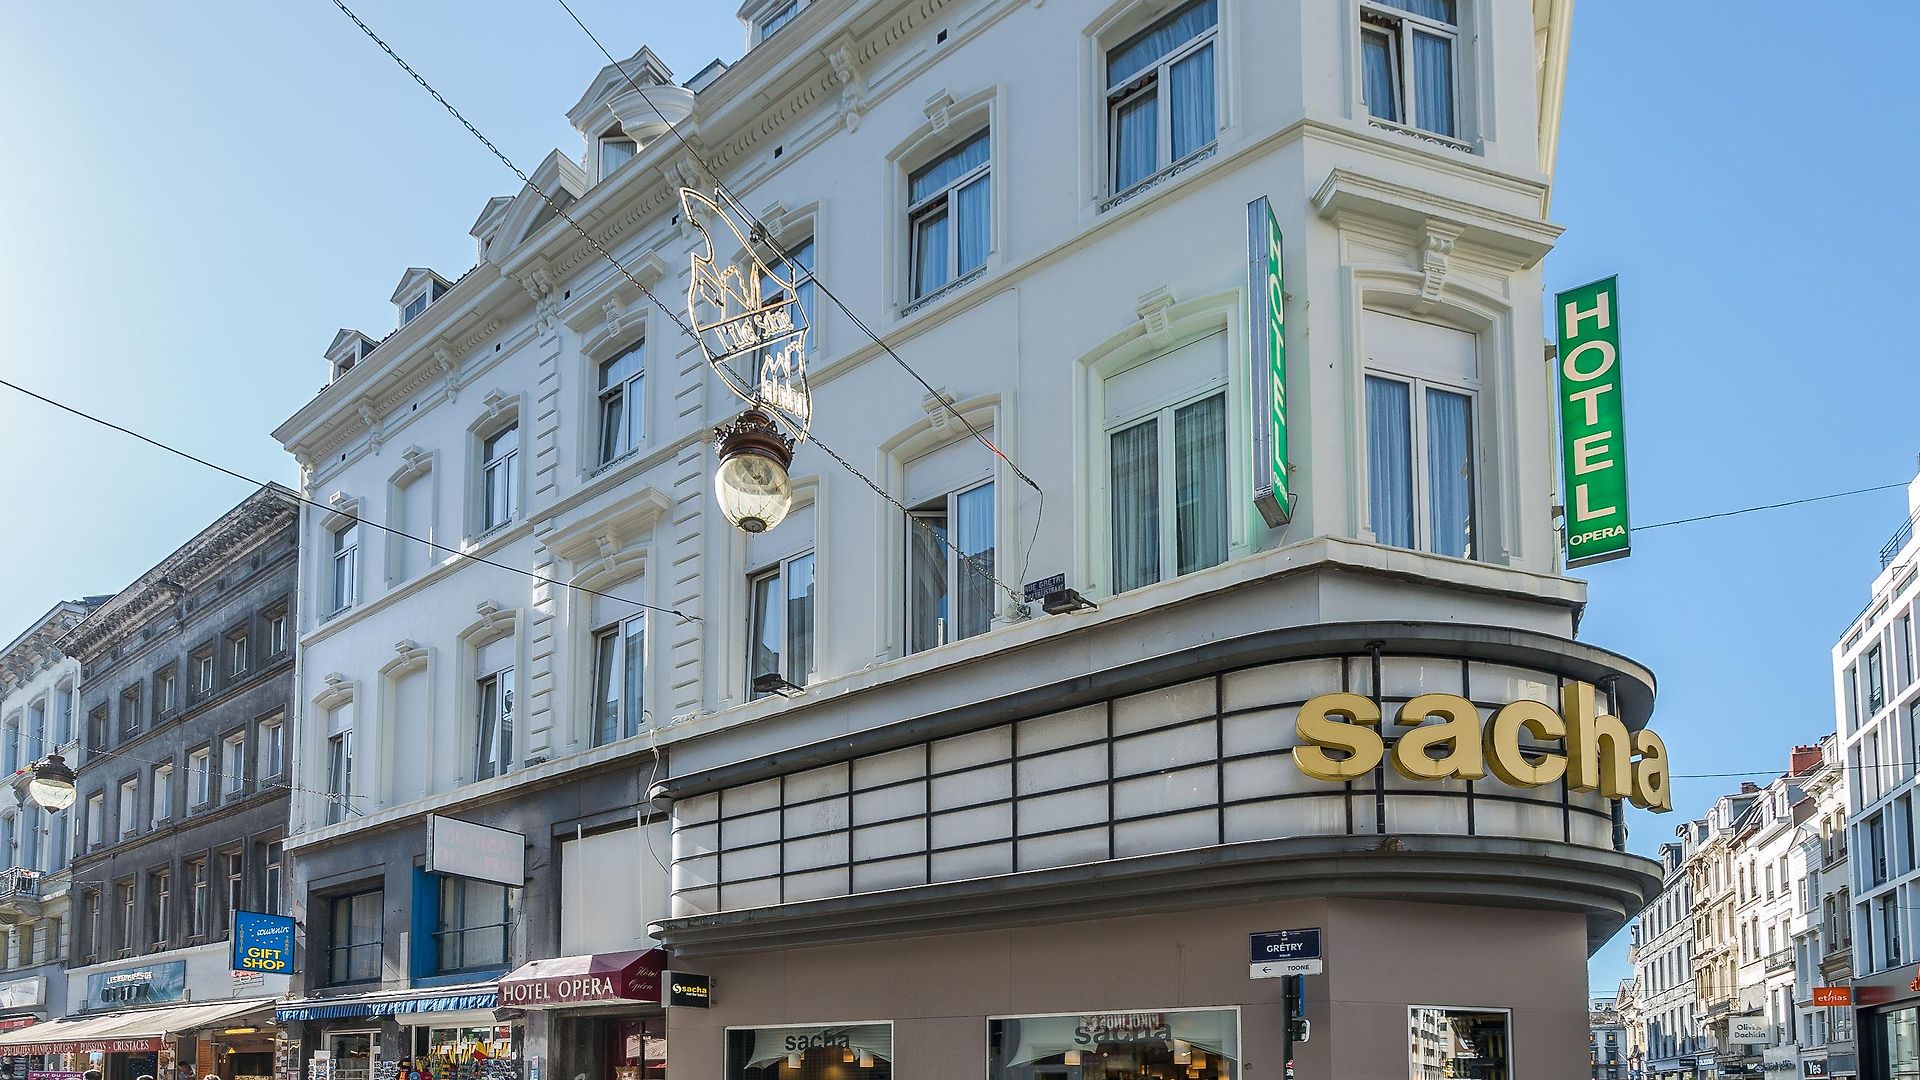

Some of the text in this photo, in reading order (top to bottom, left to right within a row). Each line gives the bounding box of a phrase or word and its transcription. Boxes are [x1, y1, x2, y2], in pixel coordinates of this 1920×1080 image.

[1270, 219, 1286, 475] HOTEL
[1563, 291, 1616, 522] HOTEL
[1569, 525, 1626, 546] OPERA
[1292, 680, 1673, 814] sacha
[248, 947, 281, 960] GIFT
[1266, 942, 1303, 953] GRÉTRY
[243, 957, 285, 970] SHOP
[503, 976, 614, 1001] HOTEL OPERA
[681, 985, 708, 994] sacha
[1818, 990, 1847, 1002] ethias
[1074, 1018, 1172, 1045] sacha
[784, 1033, 850, 1051] sacha
[1808, 1061, 1821, 1075] Yes
